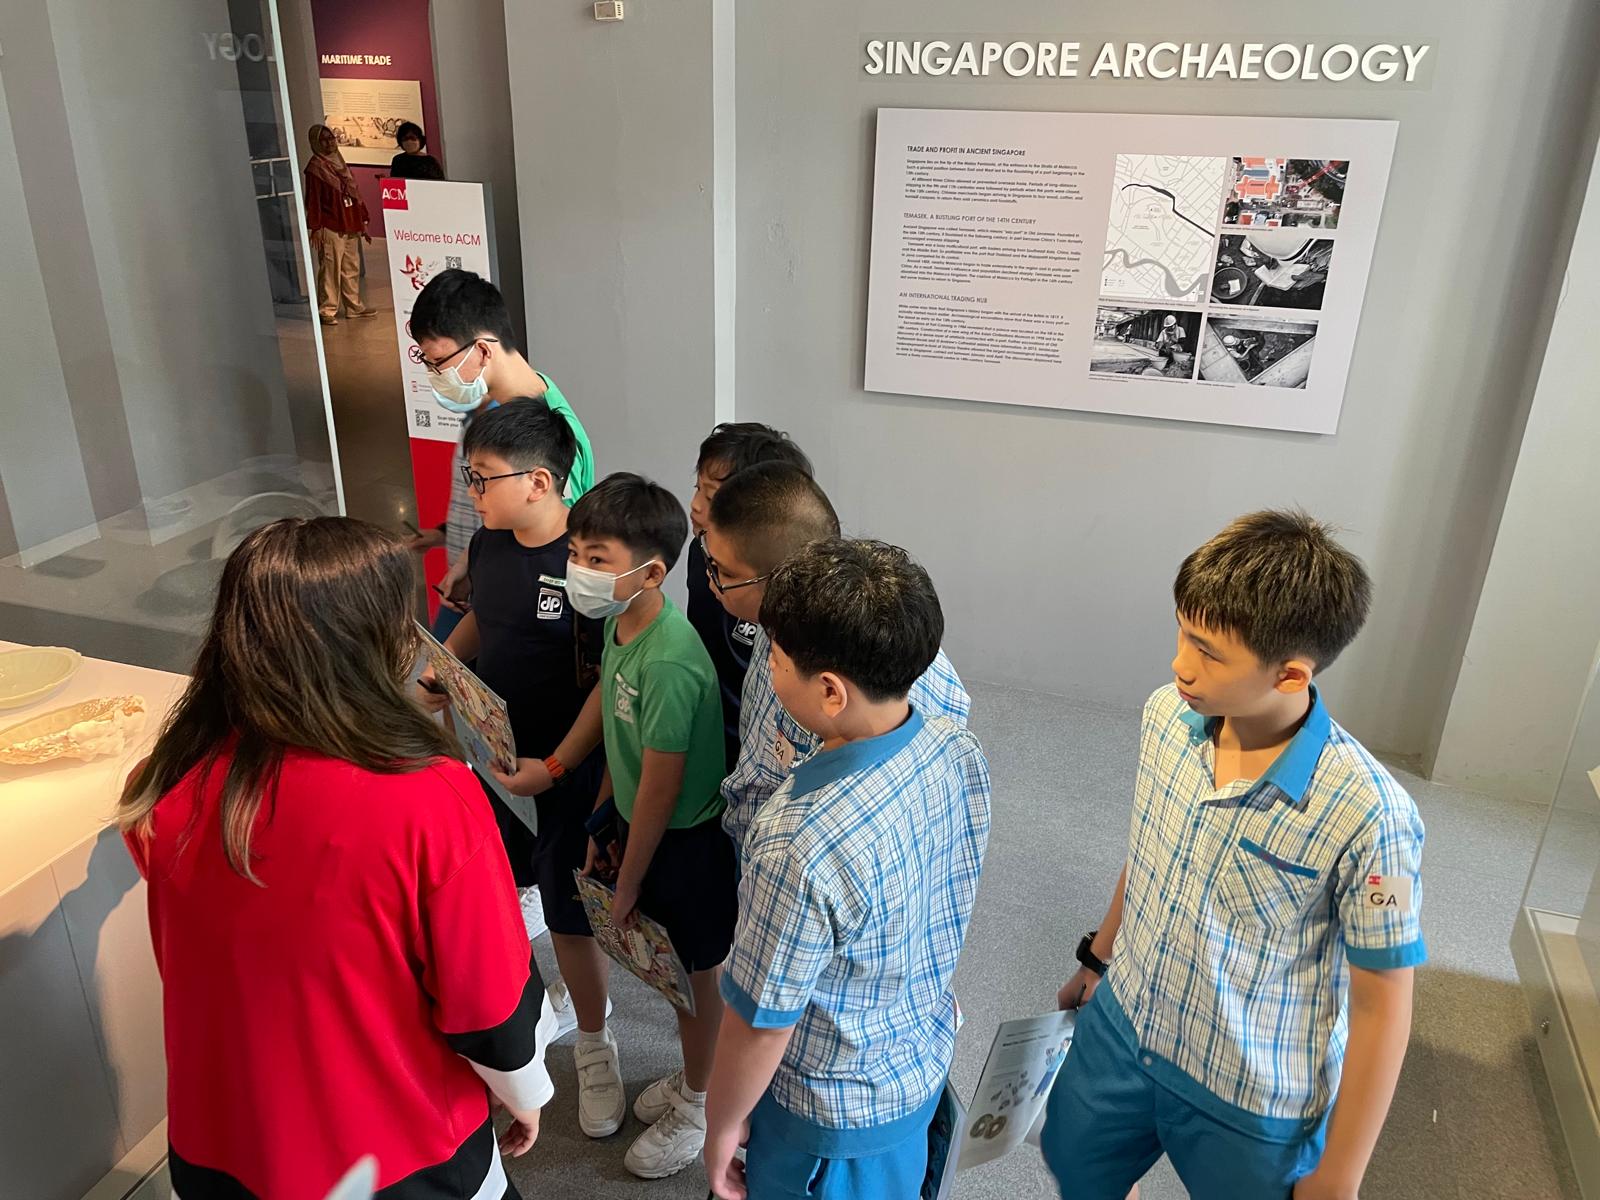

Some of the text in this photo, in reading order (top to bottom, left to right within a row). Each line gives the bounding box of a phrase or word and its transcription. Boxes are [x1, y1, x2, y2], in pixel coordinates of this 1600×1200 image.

[321, 54, 392, 66] MARITIME TRADE
[864, 40, 1431, 82] SINGAPORE ARCHAEOLOGY
[381, 188, 407, 200] ACM
[394, 229, 481, 246] Welcome to ACM
[775, 741, 784, 760] GA
[1370, 892, 1398, 907] GA
